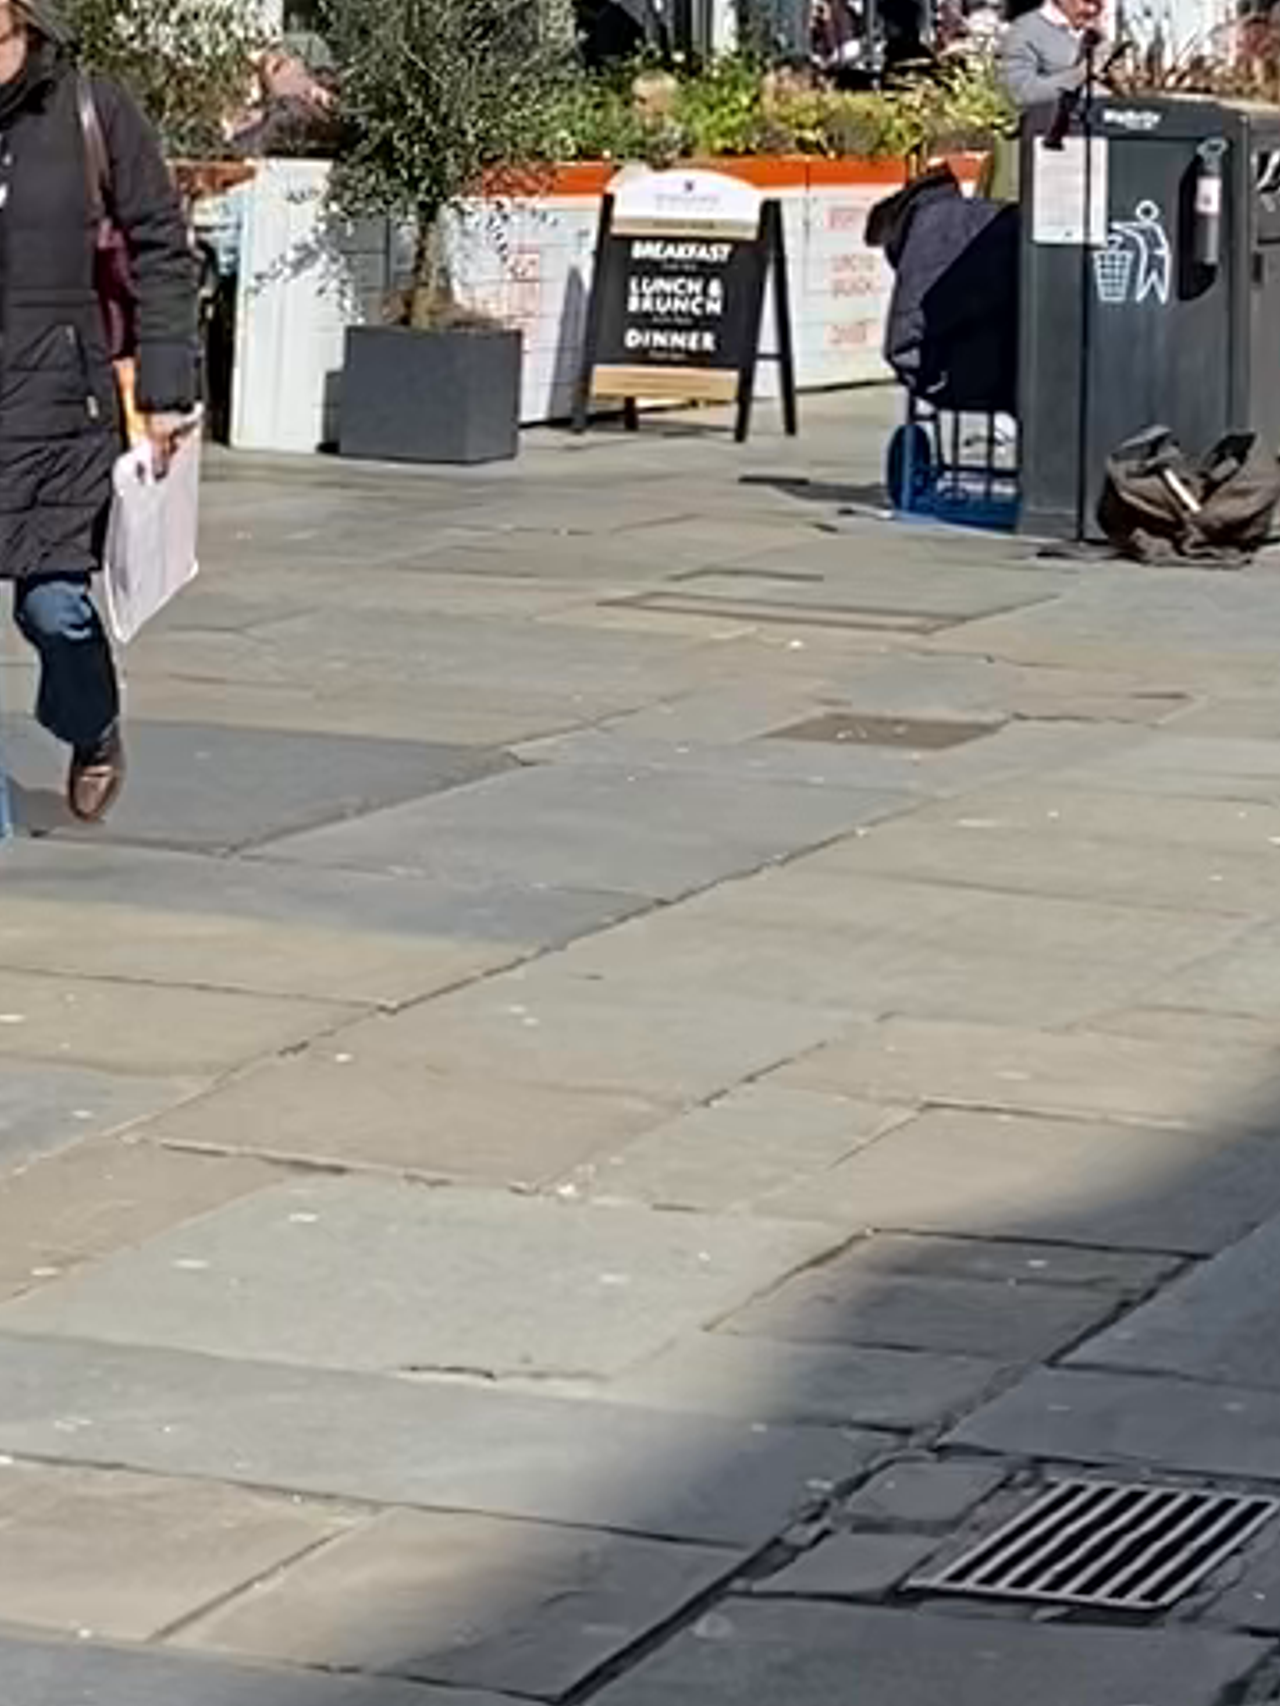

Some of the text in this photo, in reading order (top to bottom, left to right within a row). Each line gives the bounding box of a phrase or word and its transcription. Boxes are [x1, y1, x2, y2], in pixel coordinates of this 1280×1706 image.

[631, 240, 733, 263] BREAKFAST
[630, 276, 704, 296] LUNCH
[627, 296, 723, 316] BRUNCH
[624, 328, 717, 352] DINNER
